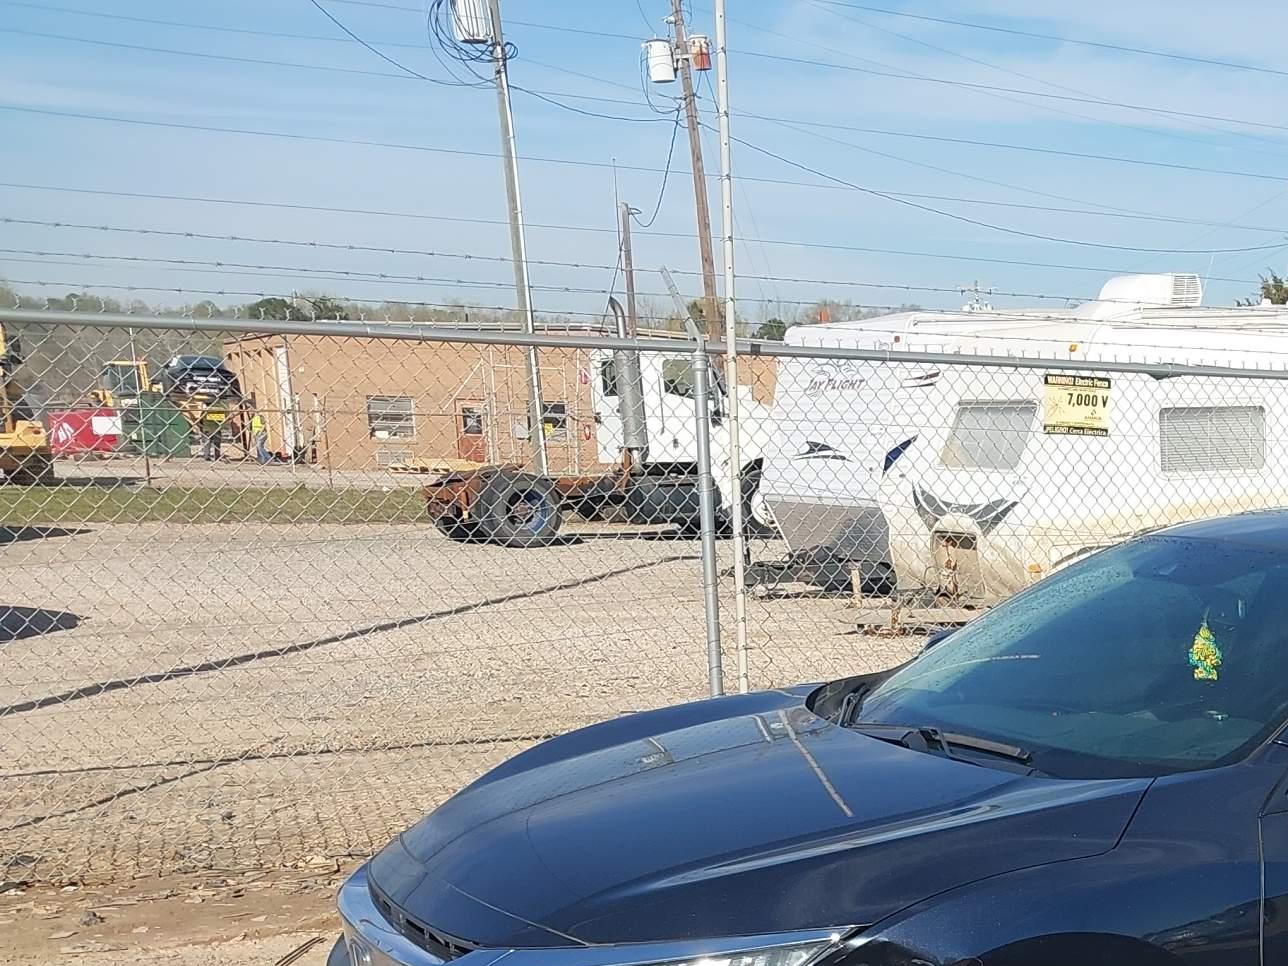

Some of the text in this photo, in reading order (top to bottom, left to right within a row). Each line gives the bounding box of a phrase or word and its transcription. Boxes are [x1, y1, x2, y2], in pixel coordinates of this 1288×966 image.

[824, 378, 866, 391] FLIGHT
[1067, 393, 1108, 408] 7,000 V
